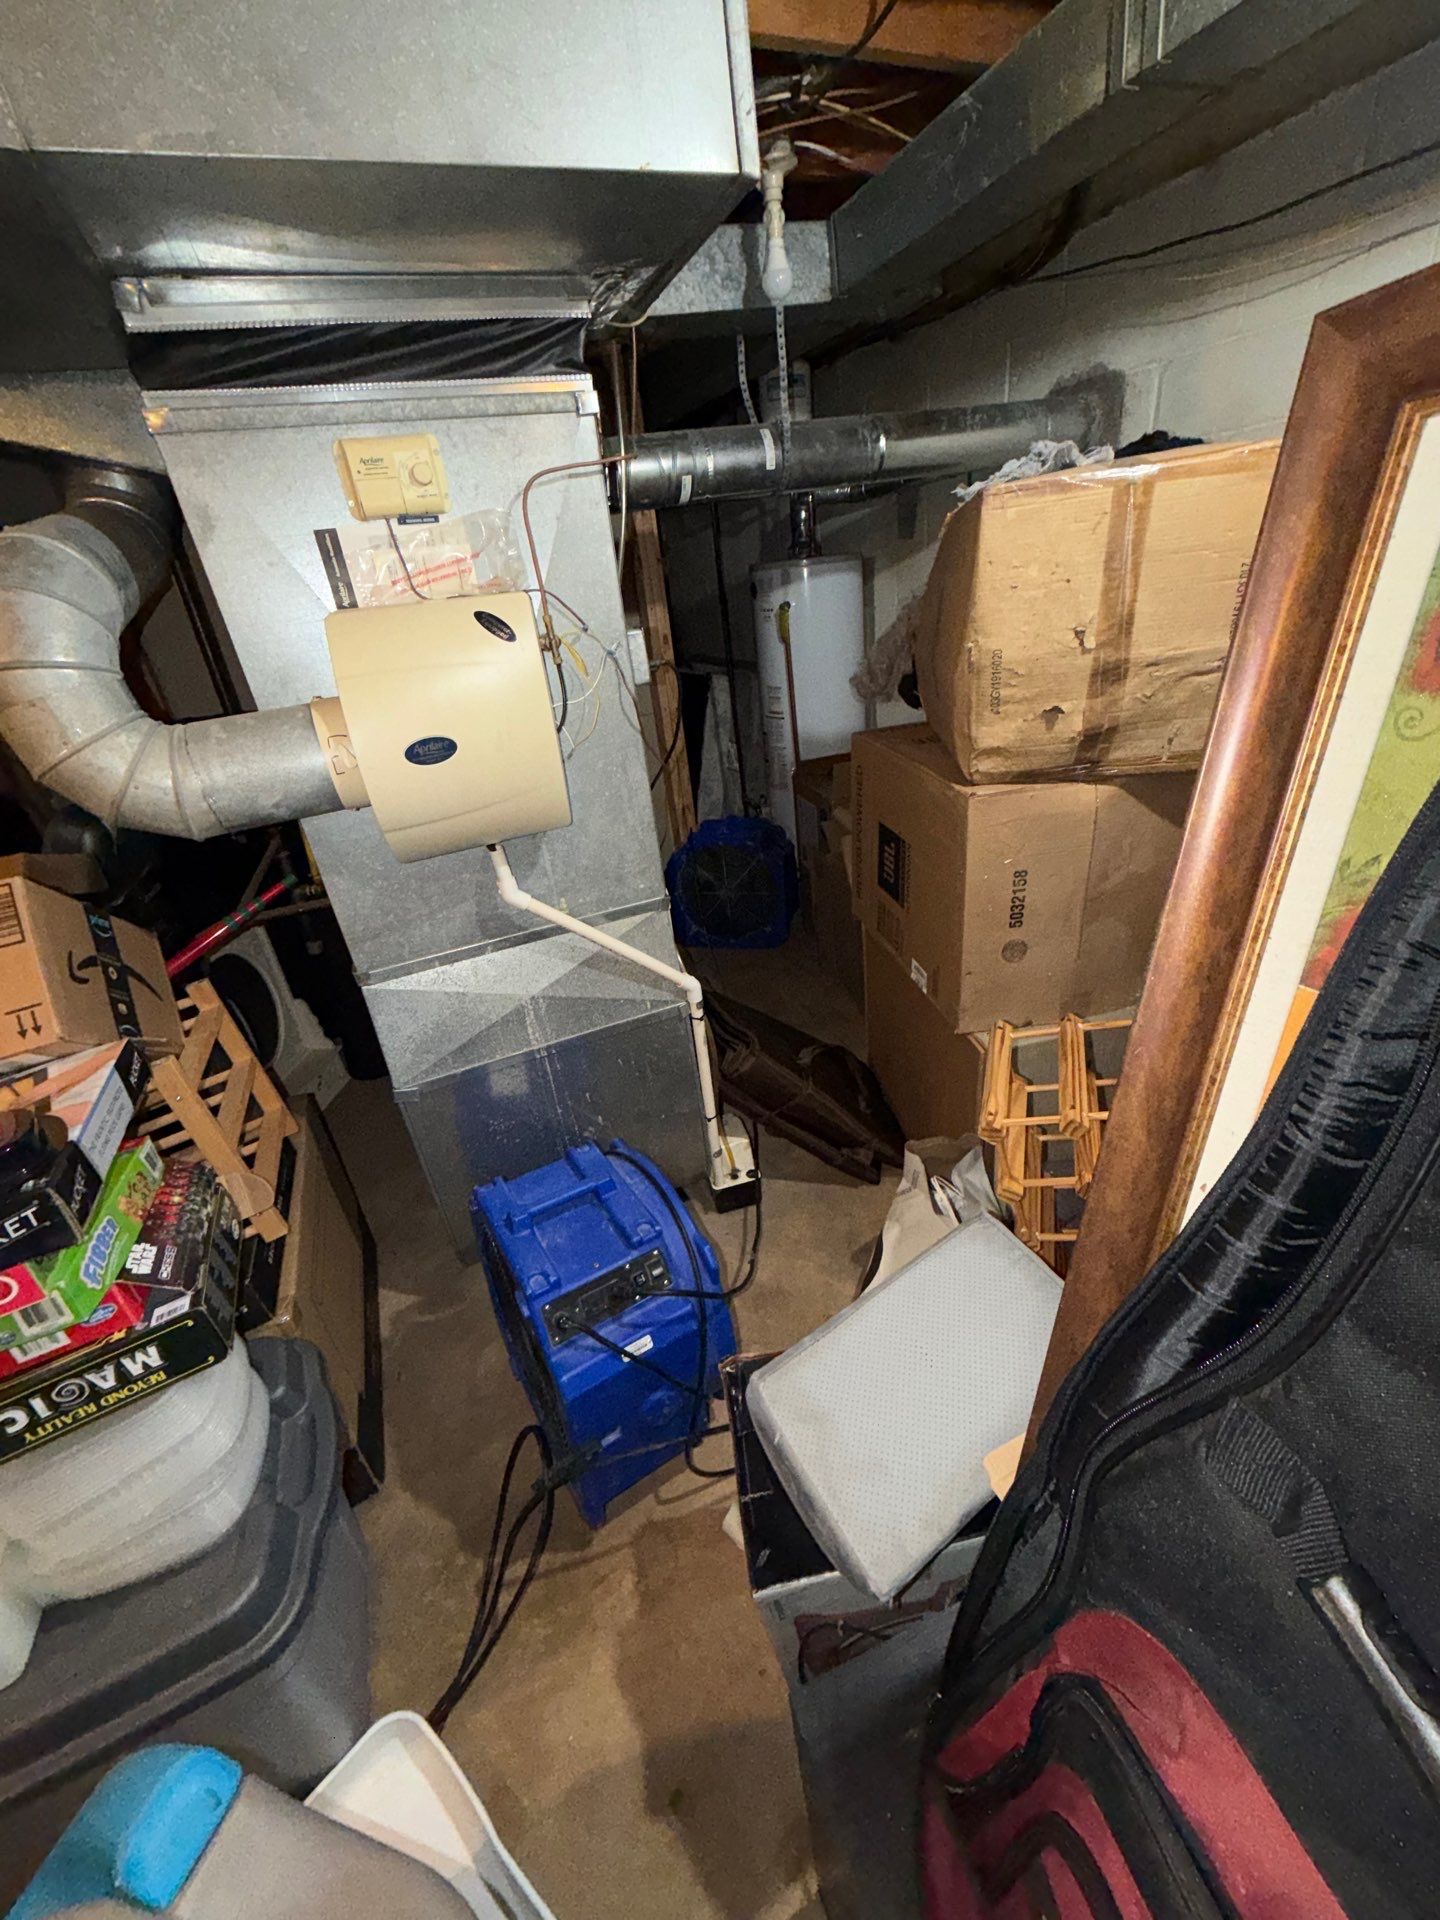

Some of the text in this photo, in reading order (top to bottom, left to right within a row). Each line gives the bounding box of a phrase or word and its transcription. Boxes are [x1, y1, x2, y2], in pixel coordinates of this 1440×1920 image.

[1008, 868, 1029, 930] 5032158
[0, 1205, 39, 1243] ET
[125, 1241, 145, 1274] STAR
[138, 1242, 158, 1275] WARS
[23, 1370, 167, 1444] BEYOND REALITY
